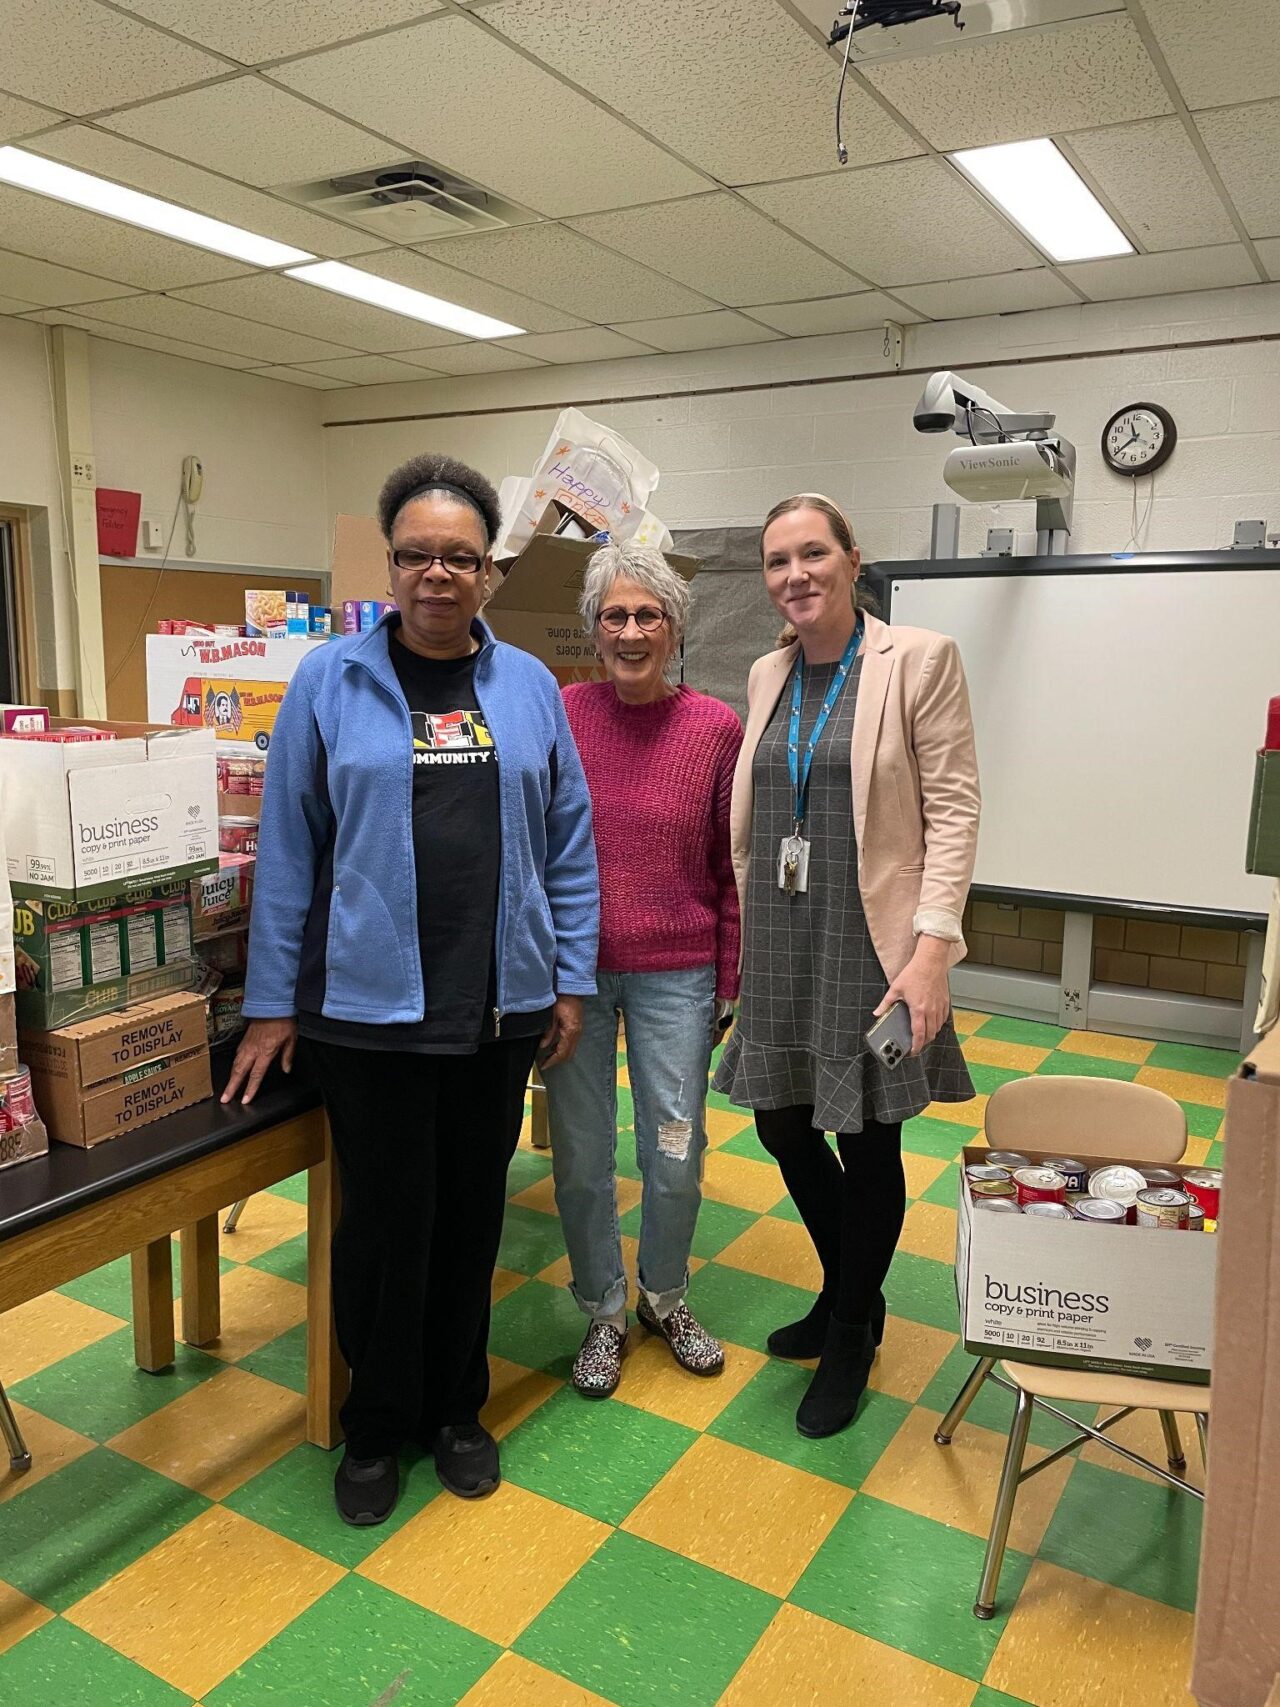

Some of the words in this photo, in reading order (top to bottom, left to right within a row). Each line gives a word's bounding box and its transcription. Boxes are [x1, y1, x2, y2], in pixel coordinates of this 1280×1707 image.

[1123, 417, 1130, 425] 11
[1133, 413, 1142, 421] 12
[1114, 426, 1124, 434] 10
[960, 456, 1021, 470] ViewSonic
[1121, 452, 1127, 460] 7
[1140, 451, 1147, 459] 5
[547, 461, 611, 510] Happy
[555, 645, 581, 659] doers
[413, 751, 491, 766] MMUNITY
[79, 816, 159, 843] business
[81, 843, 102, 854] copy
[102, 842, 108, 850] &
[108, 838, 127, 851] print
[128, 834, 152, 846] paper
[30, 858, 52, 871] 99.99%
[102, 866, 109, 874] 10
[114, 863, 122, 871] 20
[29, 872, 39, 880] NO
[161, 880, 187, 896] CLUB
[201, 876, 235, 896] Juicy
[126, 888, 153, 903] CLUB
[201, 889, 232, 908] Juice
[47, 902, 78, 921] CLUB
[88, 896, 117, 912] CLUB
[13, 908, 35, 936] UB
[121, 1019, 174, 1047] REMOVE
[112, 1049, 130, 1064] TO
[133, 1030, 184, 1058] DISPLAY
[124, 1077, 176, 1108] REMOVE
[115, 1110, 132, 1125] TO
[136, 1087, 185, 1117] DISPLAY
[985, 1274, 1109, 1313] business
[985, 1301, 1015, 1315] copy
[1016, 1306, 1023, 1315] &
[1026, 1306, 1055, 1320] print
[1057, 1311, 1094, 1324] paper
[984, 1329, 1001, 1338] 5000
[1006, 1332, 1015, 1340] 10
[1021, 1334, 1031, 1342] 20
[1036, 1336, 1045, 1344] 92
